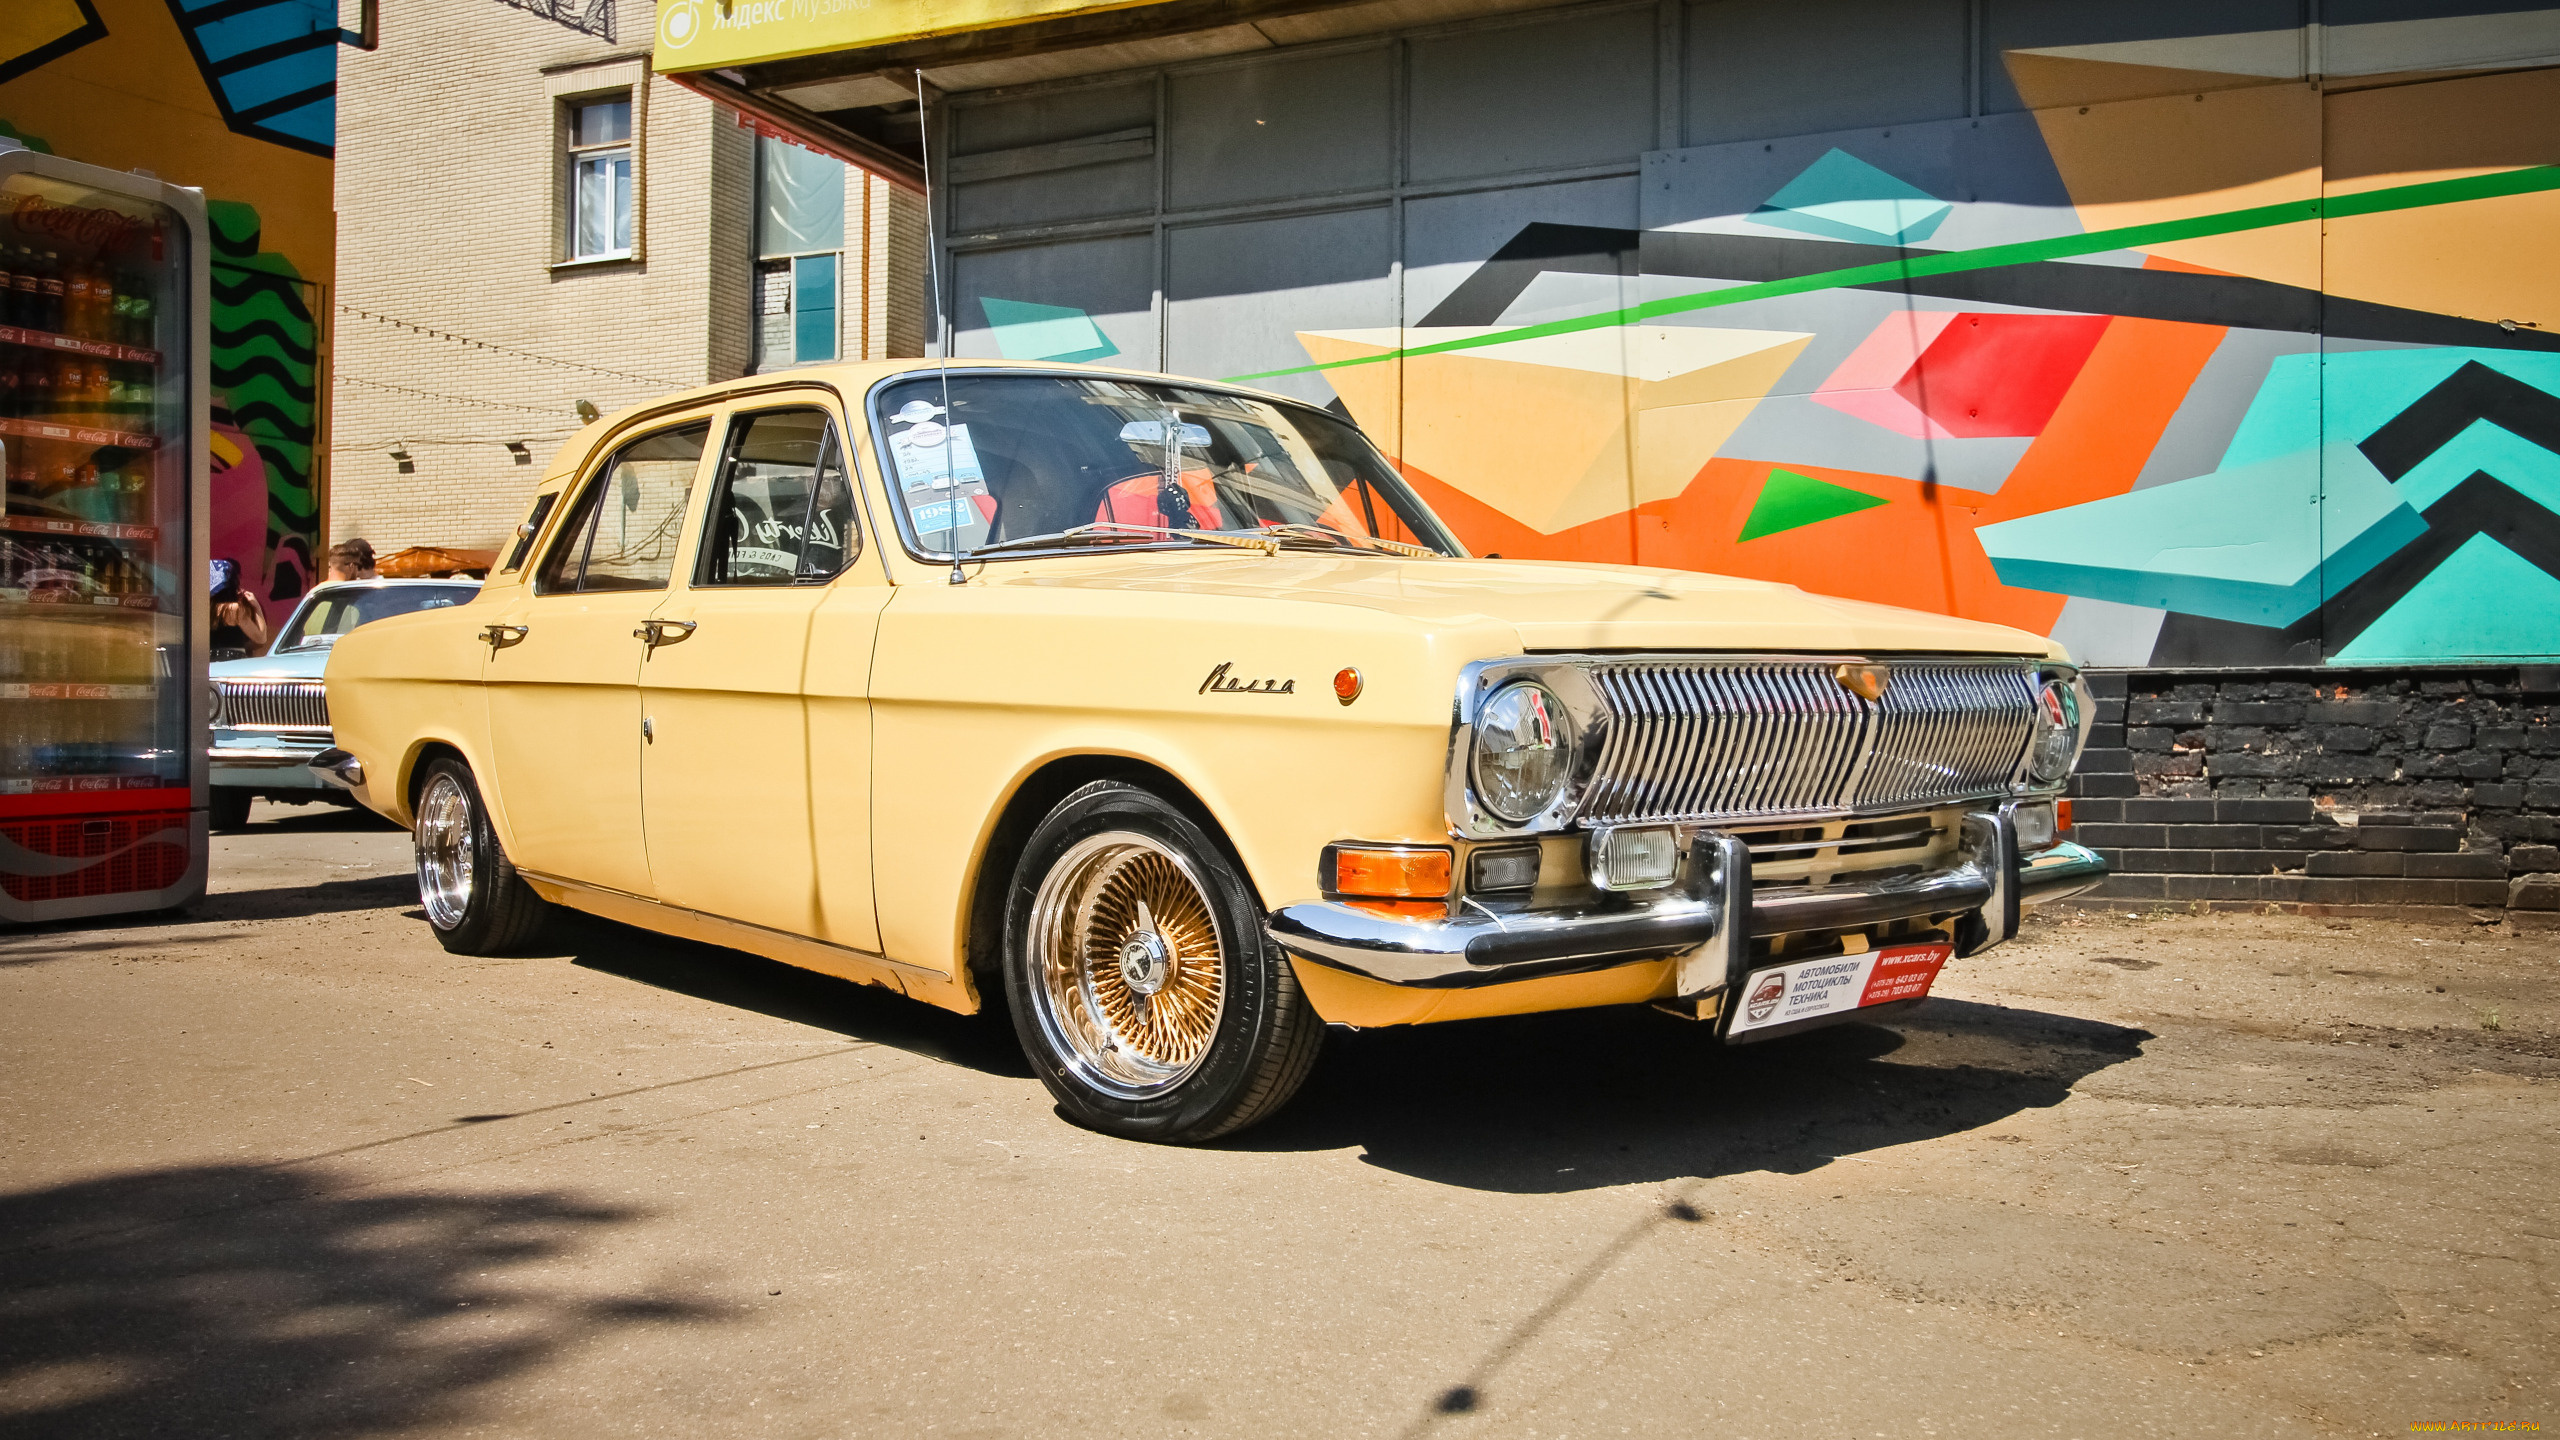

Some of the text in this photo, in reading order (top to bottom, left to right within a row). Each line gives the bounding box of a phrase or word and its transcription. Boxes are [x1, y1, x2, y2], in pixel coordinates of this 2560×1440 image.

[917, 501, 966, 522] 1982
[1881, 950, 1941, 966] www.xcars.by
[1797, 961, 1861, 980] АВТОМОБИЛИ
[1907, 973, 1918, 982] 03
[1917, 972, 1928, 981] 07
[1792, 975, 1853, 993] МОТОЦИКЛЫ
[1902, 984, 1912, 993] 03
[1912, 983, 1922, 992] 07
[1788, 990, 1829, 1006] ТЕХНИКА
